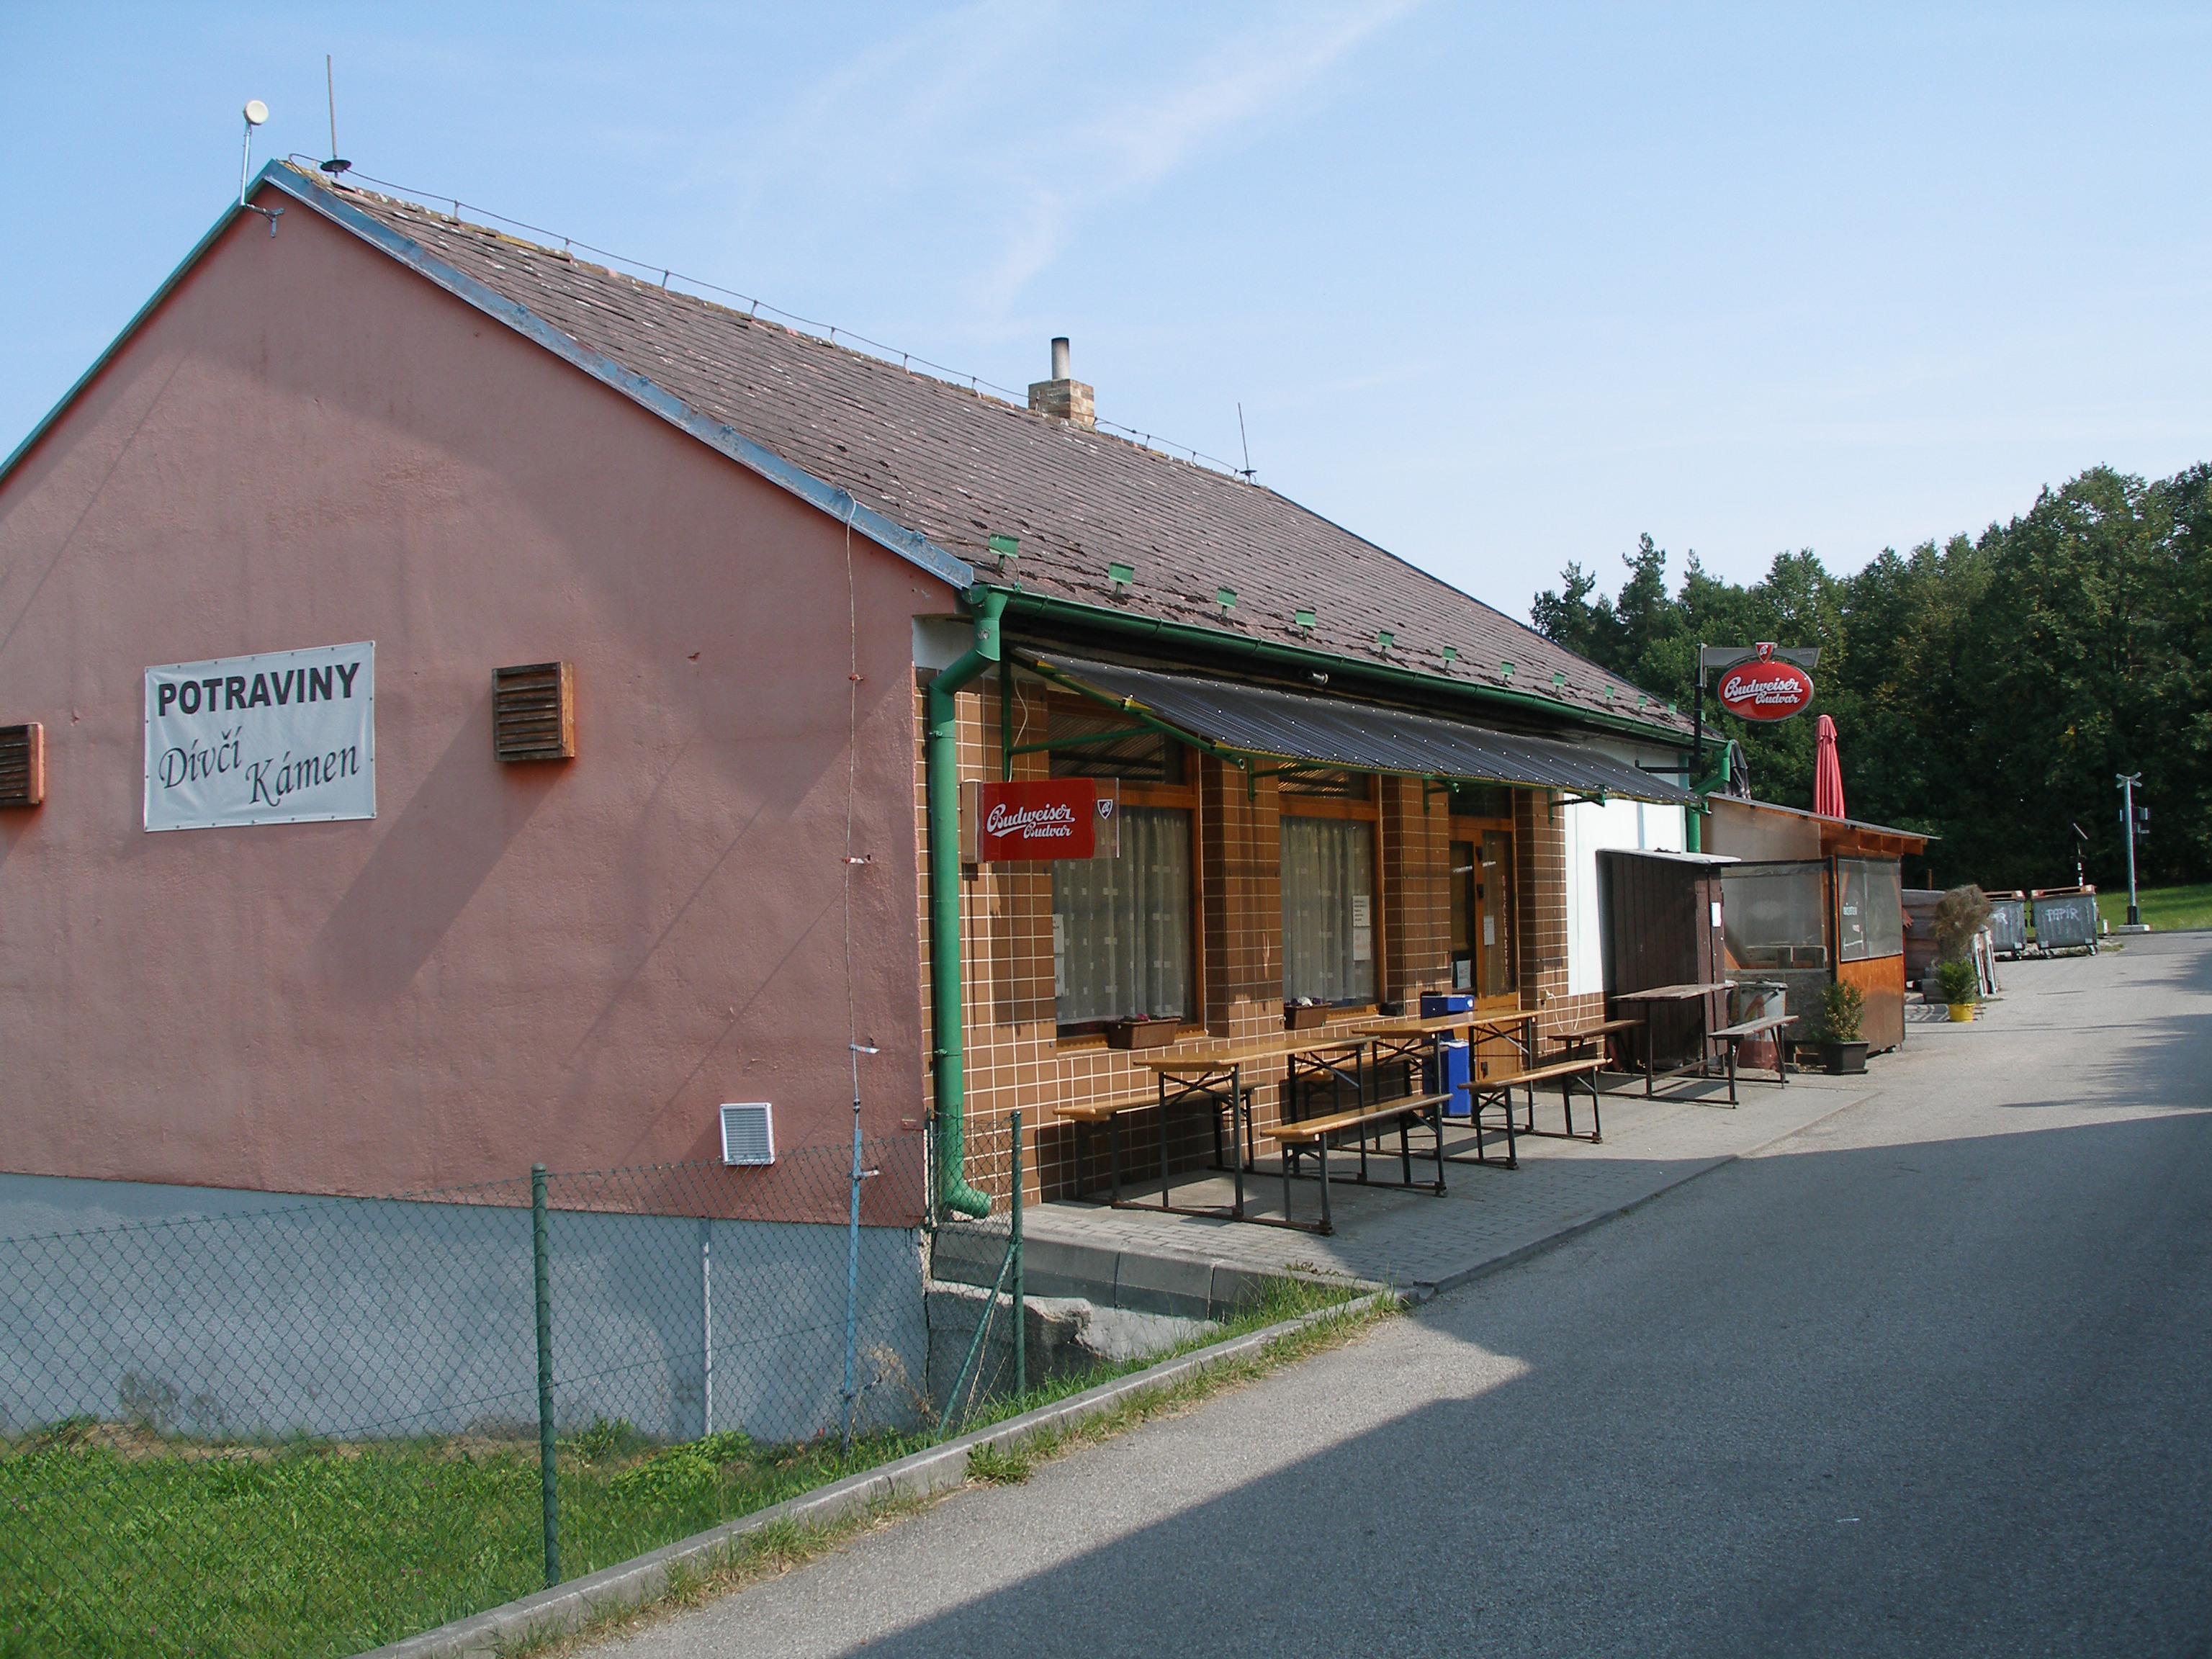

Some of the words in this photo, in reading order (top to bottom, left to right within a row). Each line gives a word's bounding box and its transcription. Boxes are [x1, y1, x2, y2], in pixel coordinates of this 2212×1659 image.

[158, 662, 361, 717] POTRAVINY
[1724, 675, 1803, 700] Budweiser
[1755, 691, 1801, 704] Budvar
[158, 725, 243, 789] Dívčí
[245, 745, 361, 807] Kámen
[986, 802, 1076, 835] Budweiser
[1023, 822, 1073, 839] Budvar
[2044, 902, 2080, 922] PAPÍR
